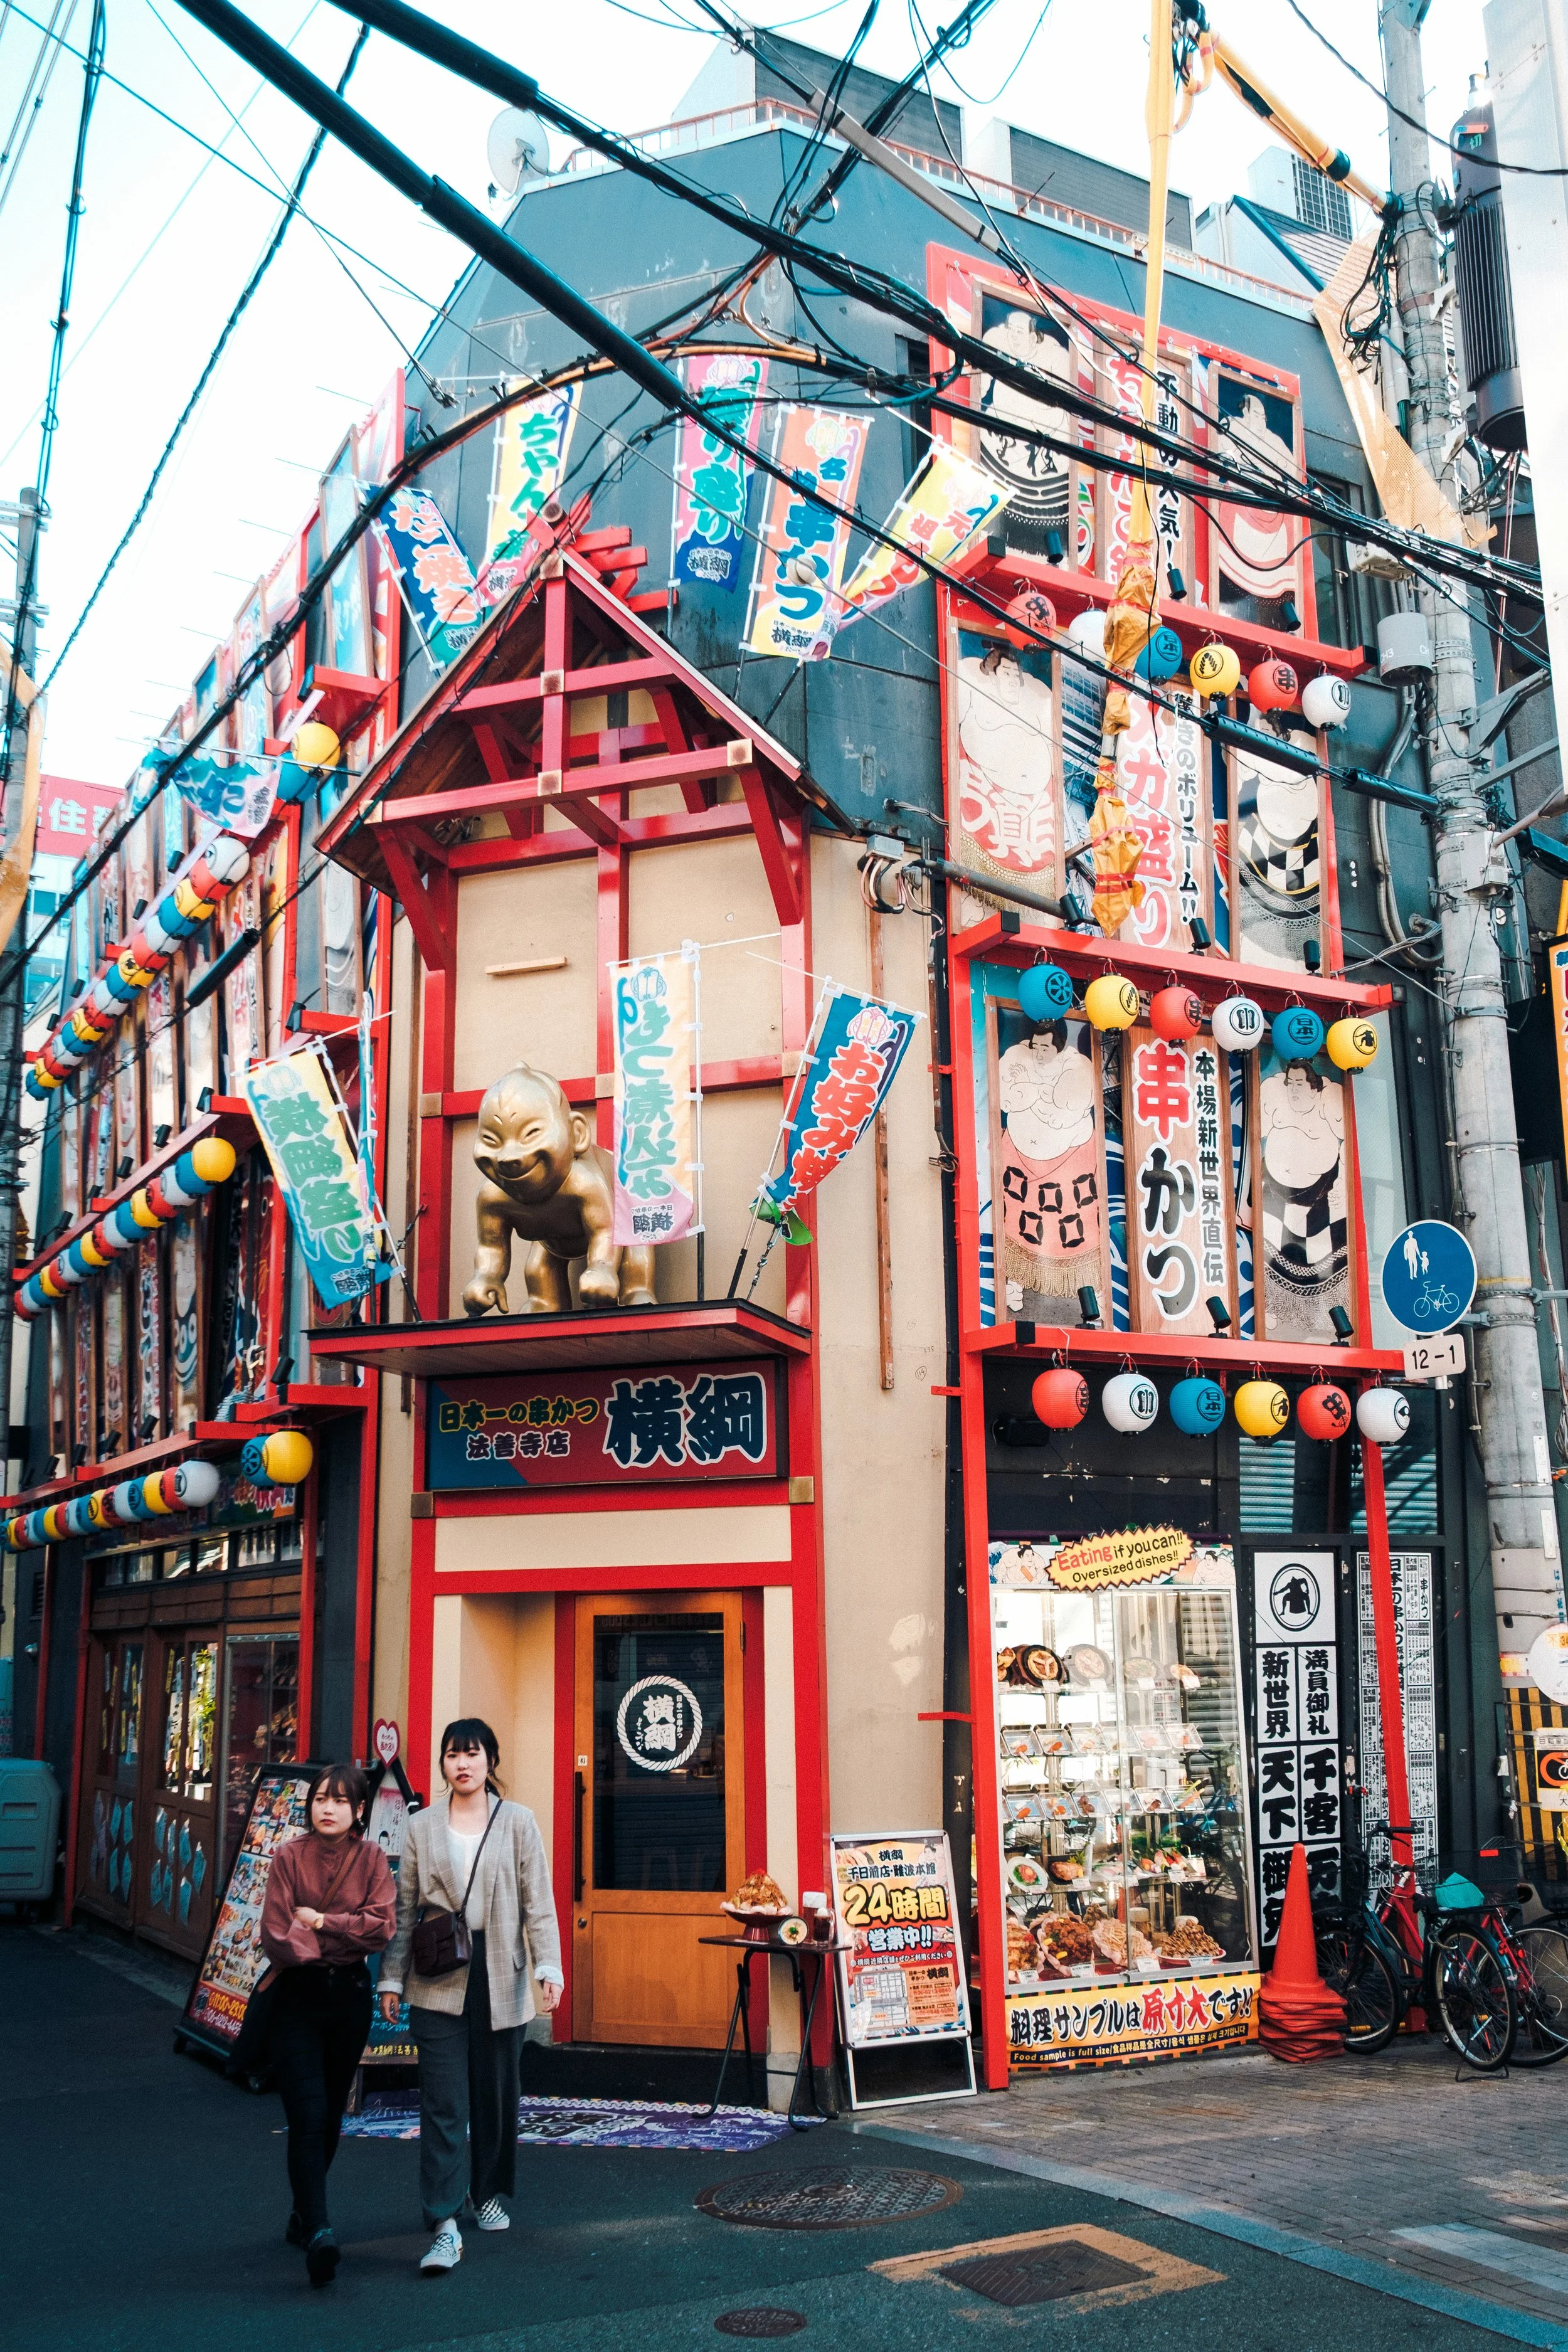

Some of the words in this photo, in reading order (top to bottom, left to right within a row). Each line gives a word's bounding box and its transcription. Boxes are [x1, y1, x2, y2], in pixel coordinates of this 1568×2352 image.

[1277, 667, 1296, 691] 串
[1294, 1019, 1315, 1046] 日本一
[1135, 1042, 1196, 1320] 串かつ
[1194, 1050, 1225, 1286] 本場新世界直伝
[1411, 1344, 1457, 1371] 12-1
[439, 1396, 600, 1433] 日本一の串かつ
[603, 1372, 766, 1468] 横綱
[1205, 1392, 1224, 1421] 日本一
[467, 1429, 571, 1461] 法善寺店
[1057, 1545, 1113, 1572] Eating
[1114, 1545, 1125, 1560] if
[1073, 1561, 1134, 1583] Oversized
[1135, 1550, 1179, 1569] dishes!!
[1420, 1577, 1429, 1618] 串かつ
[1261, 1650, 1291, 1739] 新世界
[1305, 1649, 1330, 1736] 満員御礼
[643, 1694, 677, 1751] 横綱
[1261, 1749, 1297, 1840] 天下
[1303, 1747, 1339, 1837] 千客
[878, 1849, 904, 1862] 横綱
[844, 1882, 948, 1927] 24時間
[867, 1924, 933, 1952] 営業中!!
[927, 1966, 950, 1979] 横綱
[1010, 1984, 1254, 2047] 料理サンプルは原寸大です!!
[1014, 2052, 1037, 2062] Food
[1039, 2050, 1066, 2062] sample
[1068, 2048, 1075, 2058] is
[1078, 2047, 1093, 2057] full
